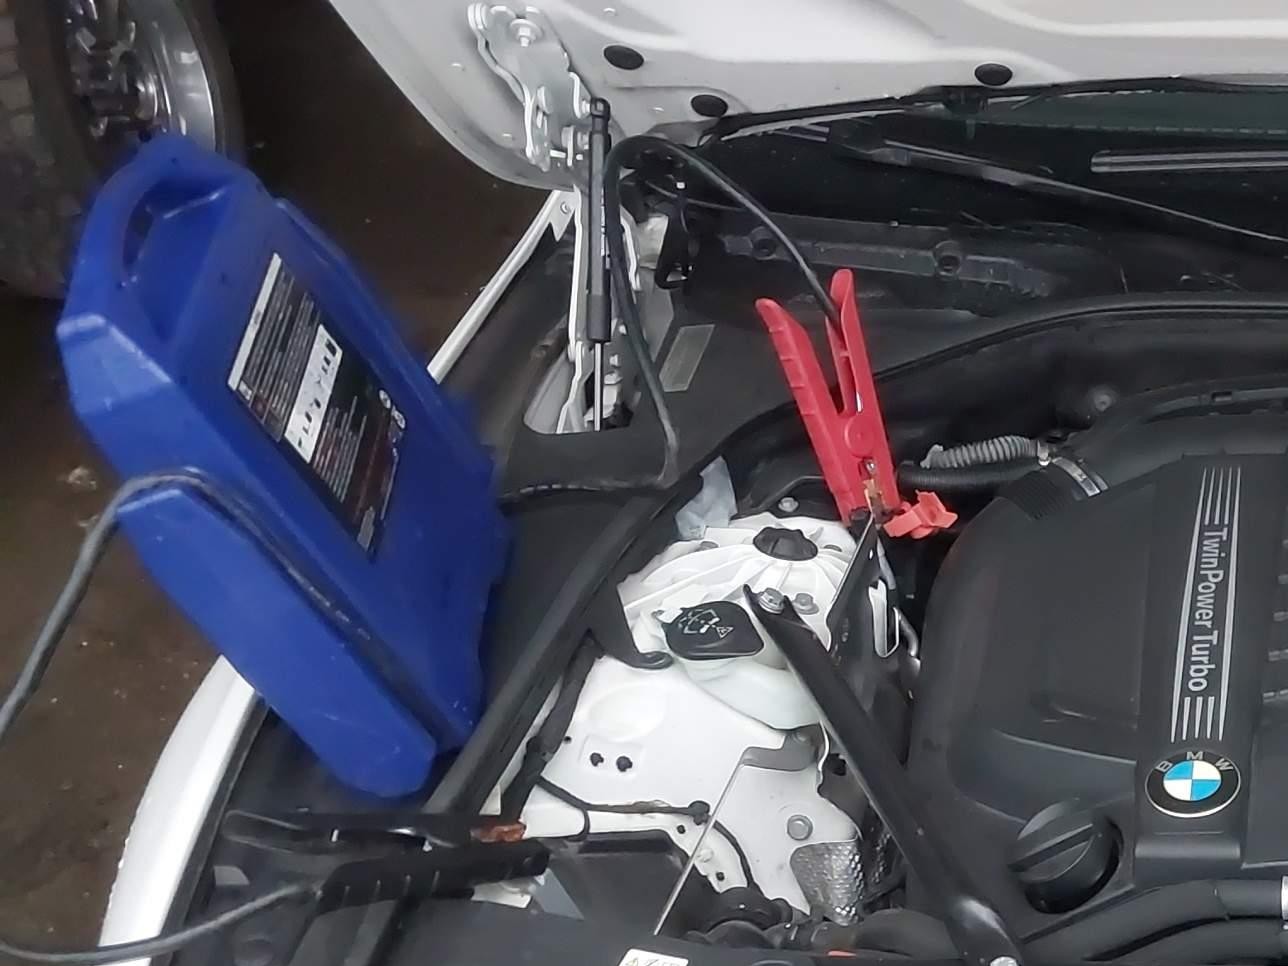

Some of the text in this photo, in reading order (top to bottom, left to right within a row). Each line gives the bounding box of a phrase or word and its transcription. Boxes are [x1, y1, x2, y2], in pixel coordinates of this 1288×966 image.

[1187, 527, 1228, 692] TwinPower Turbo
[1154, 750, 1235, 773] BMW
